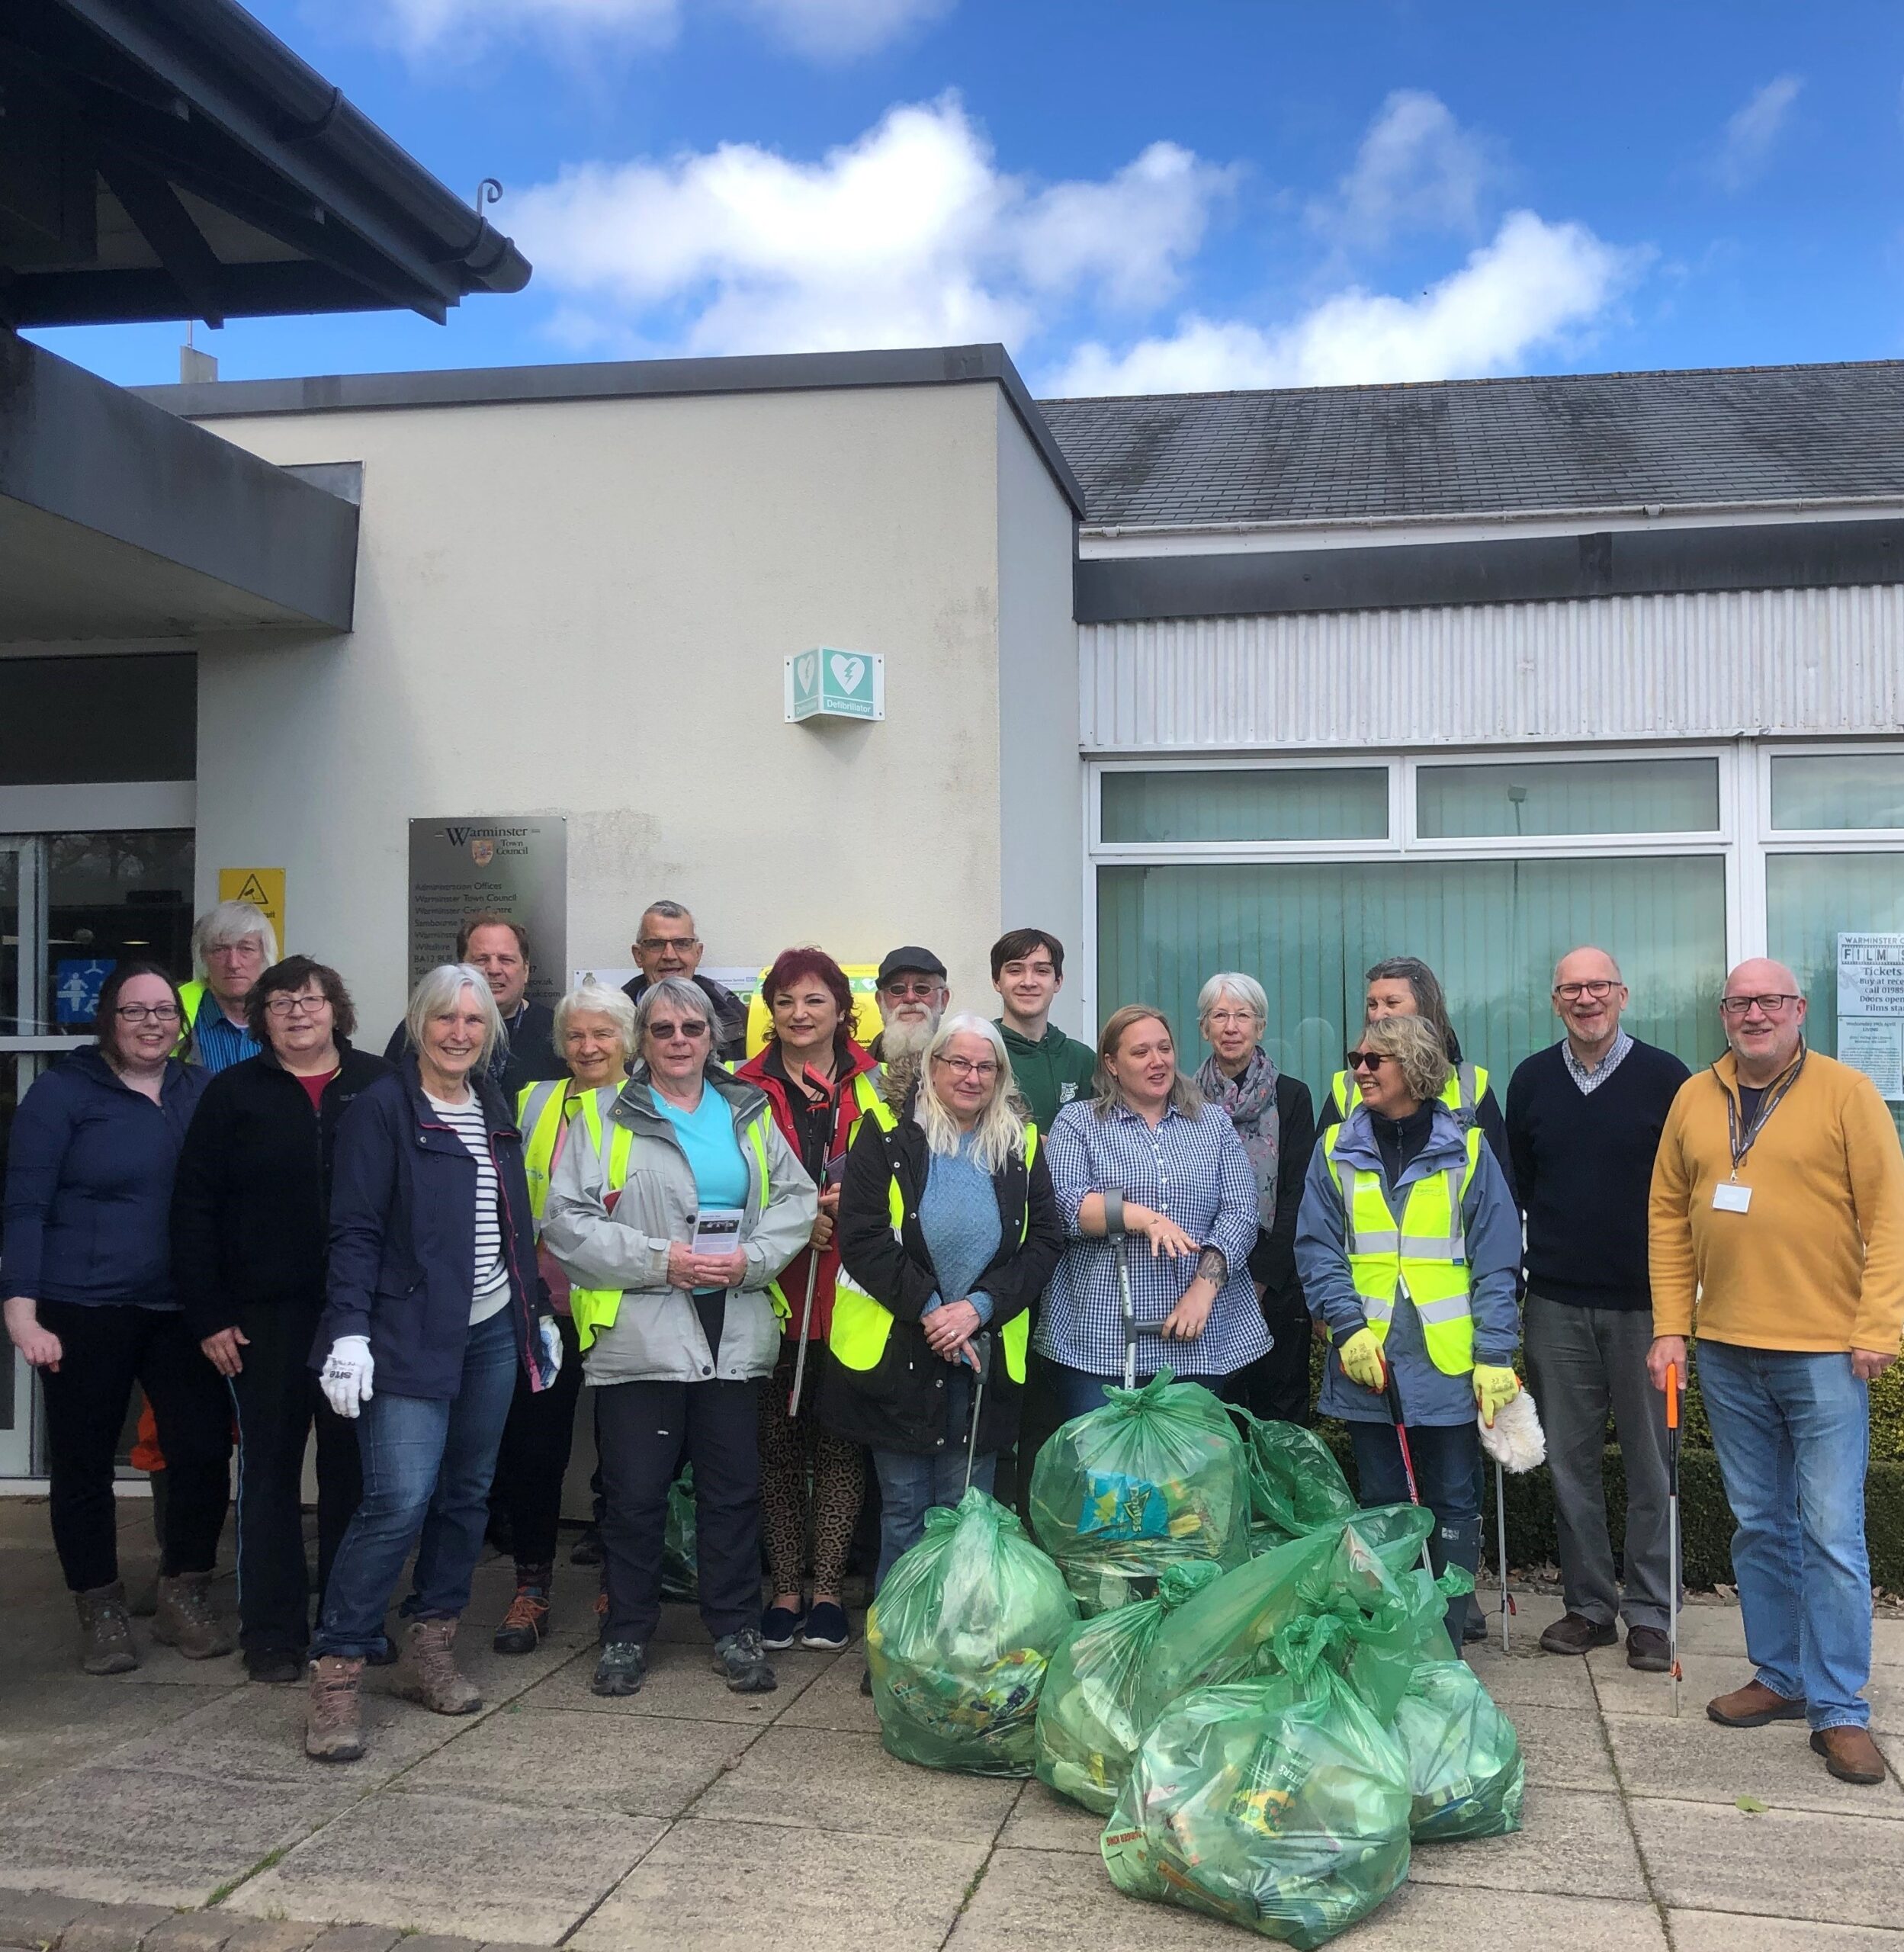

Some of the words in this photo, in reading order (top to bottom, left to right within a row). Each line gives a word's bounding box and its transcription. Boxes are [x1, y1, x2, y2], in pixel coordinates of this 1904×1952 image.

[827, 699, 871, 713] Defibrillator
[445, 827, 528, 847] Warminster
[486, 894, 517, 902] Council
[414, 919, 458, 927] Sambourne
[1844, 949, 1886, 961] FILM
[1863, 966, 1902, 976] Tickets
[1860, 978, 1876, 986] Buy
[1129, 1487, 1142, 1533] Doritos
[1106, 1835, 1120, 1847] KING
